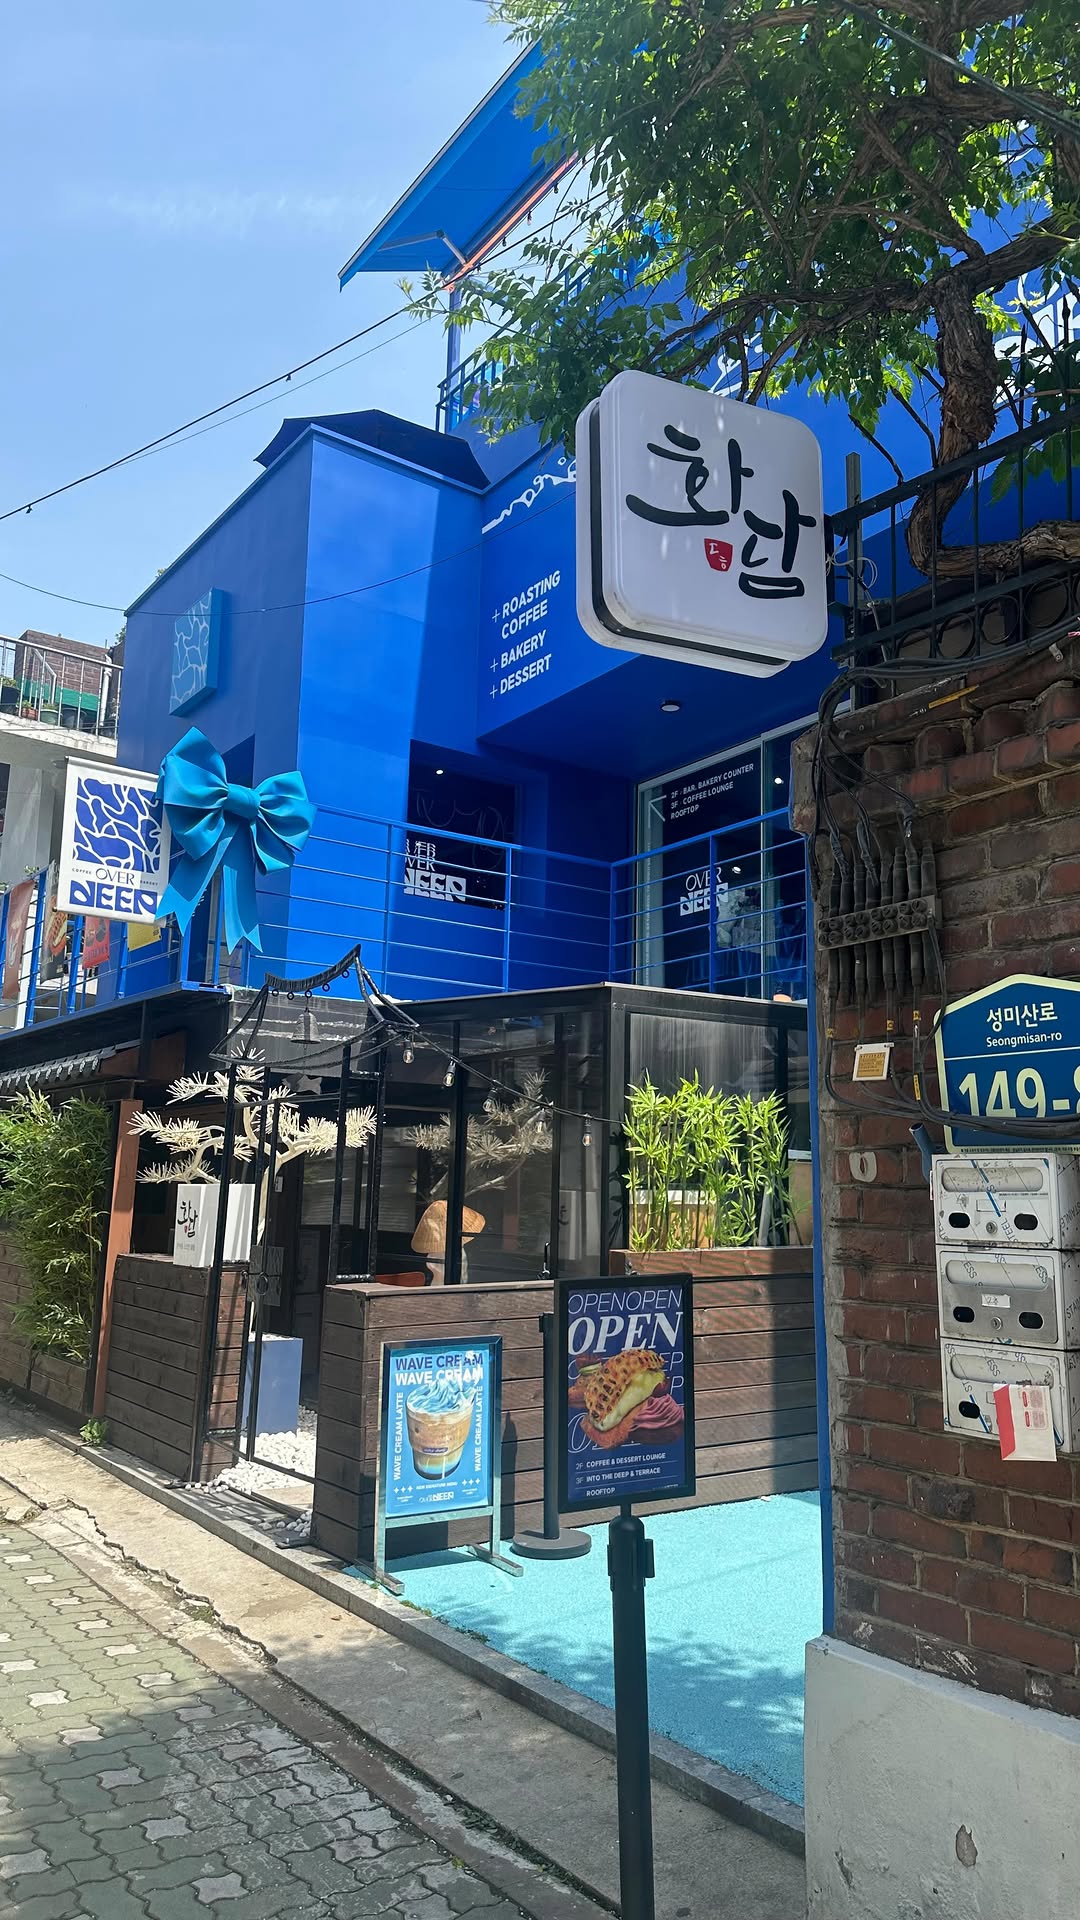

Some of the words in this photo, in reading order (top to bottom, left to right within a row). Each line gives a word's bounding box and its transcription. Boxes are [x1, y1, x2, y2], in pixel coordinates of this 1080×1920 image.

[502, 570, 561, 619] ROASTING
[501, 599, 548, 639] COFFEE
[500, 629, 547, 669] BAKERY
[500, 653, 552, 695] DESSERT
[670, 801, 678, 809] 3F
[682, 790, 707, 805] COFFEE
[708, 781, 734, 796] LOUNGE
[671, 790, 678, 799] 2F
[698, 774, 722, 790] BAKERY
[723, 763, 754, 780] COUNTER
[670, 804, 700, 820] ROOFTOP
[95, 868, 135, 886] OVER
[986, 1002, 1058, 1032] 성미산로
[986, 1032, 1062, 1048] Seongmisan-ro
[568, 1312, 684, 1356] OPEN
[395, 1356, 433, 1371] WAVE
[436, 1353, 483, 1368] CREAM
[395, 1371, 433, 1386] WAVE
[396, 1392, 404, 1420] LATTE
[476, 1386, 484, 1414] LATTE
[395, 1421, 403, 1454] CREAM
[394, 1455, 402, 1481] WAVE
[474, 1446, 482, 1472] WAVE
[586, 1459, 610, 1468] COFFEE
[616, 1454, 642, 1464] DESSERT
[642, 1452, 666, 1462] LOUNGE
[586, 1474, 600, 1482] INTO
[602, 1472, 613, 1480] THE
[614, 1470, 630, 1479] DEEP
[635, 1467, 660, 1476] TERRACE
[586, 1488, 616, 1496] ROOFTOP
